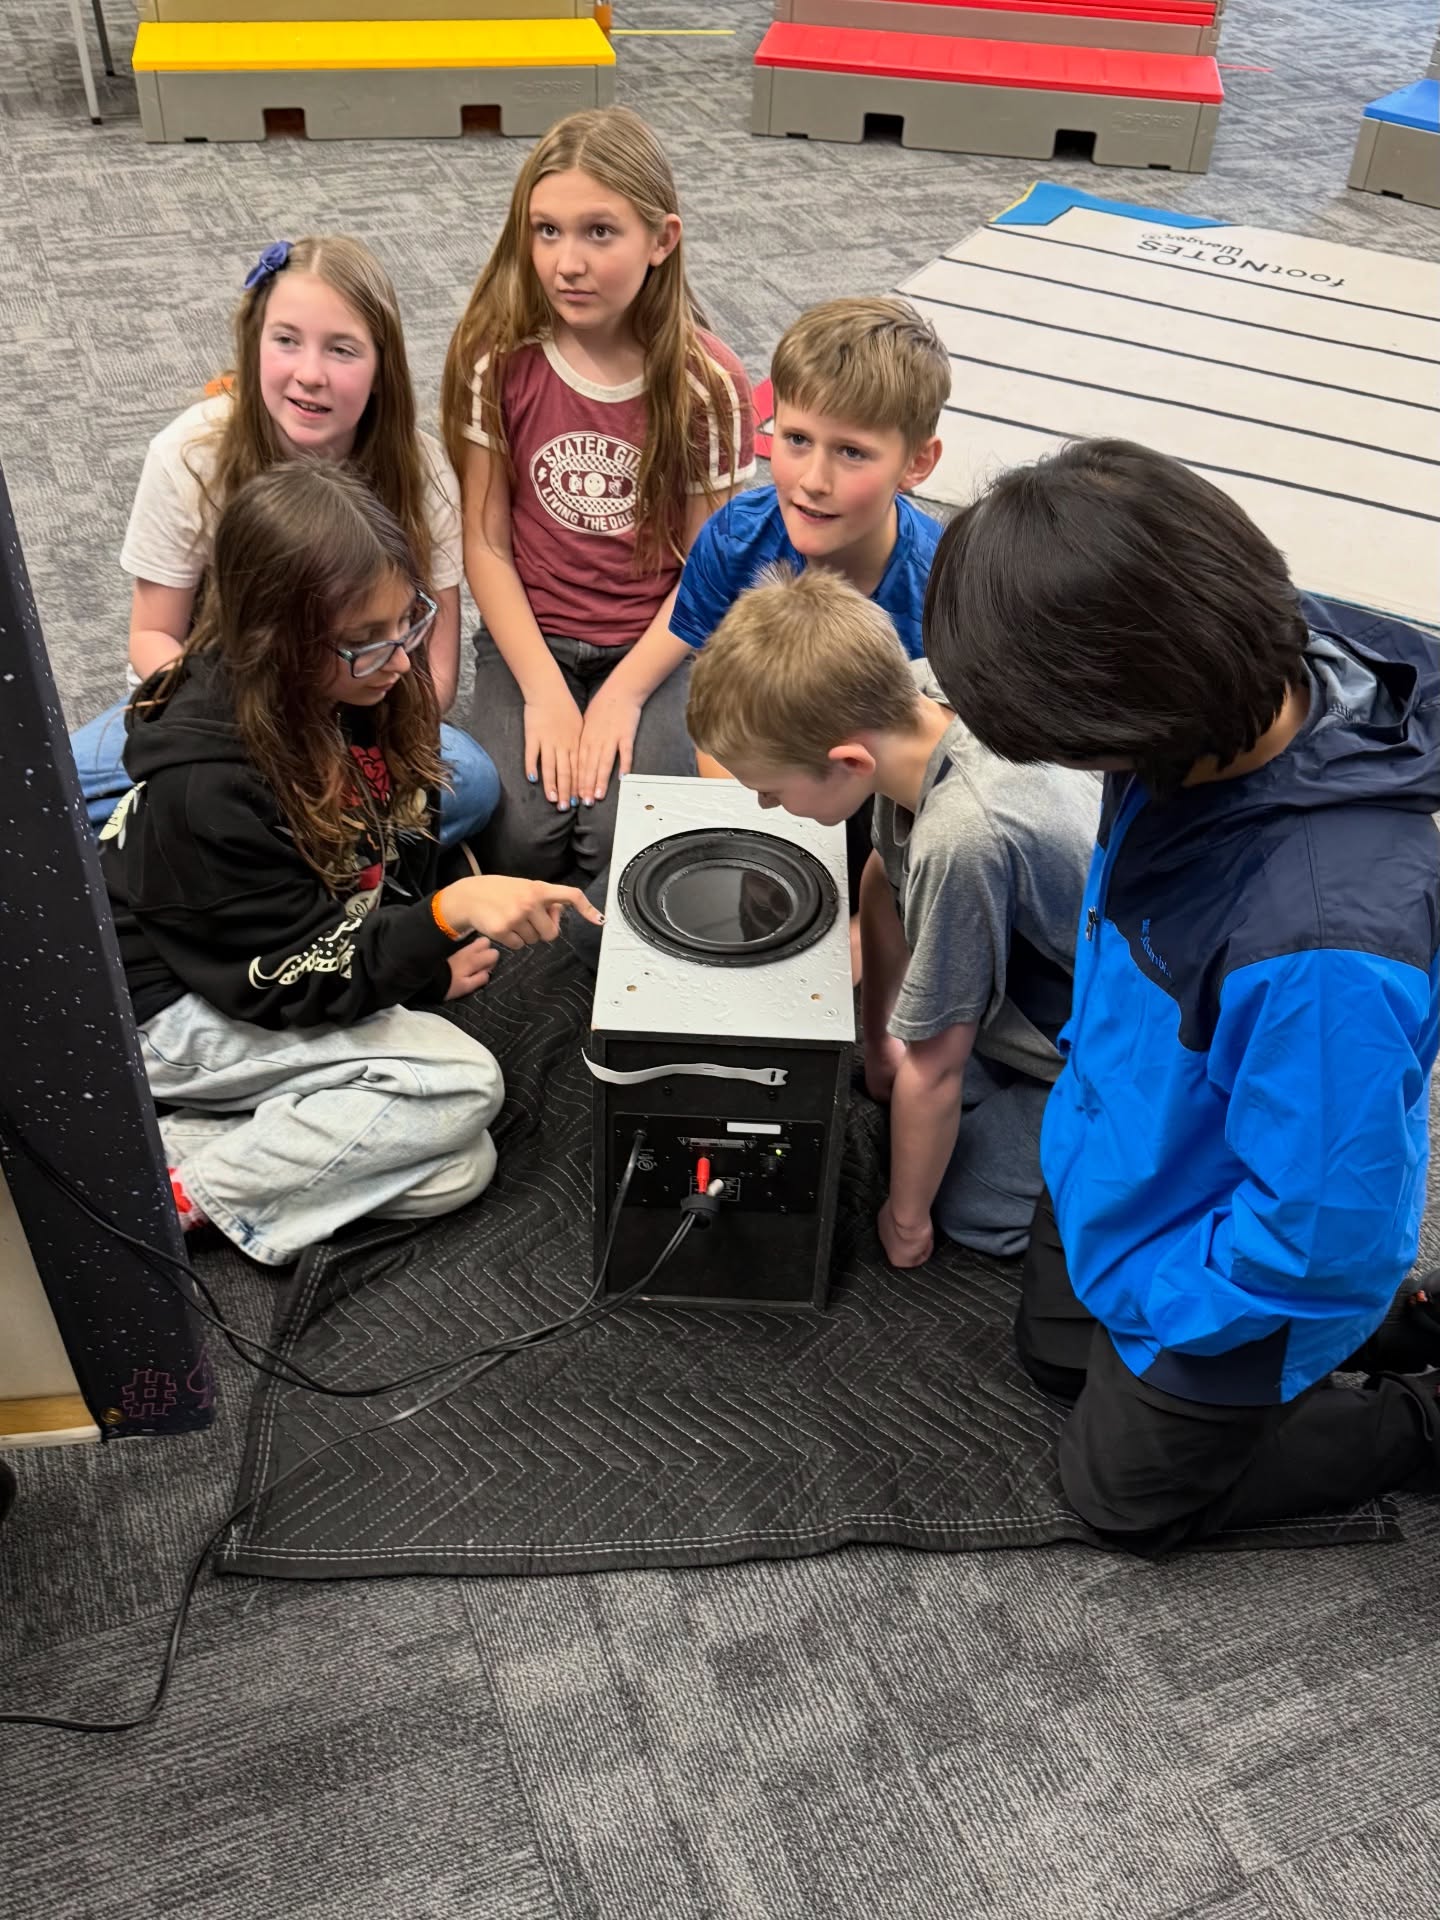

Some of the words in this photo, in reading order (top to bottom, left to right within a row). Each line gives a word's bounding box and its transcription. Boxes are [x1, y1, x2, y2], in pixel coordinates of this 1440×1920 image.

[1137, 240, 1345, 288] footNOTES
[542, 437, 608, 468] SKATER
[542, 486, 580, 525] LIVING
[582, 515, 608, 531] THE
